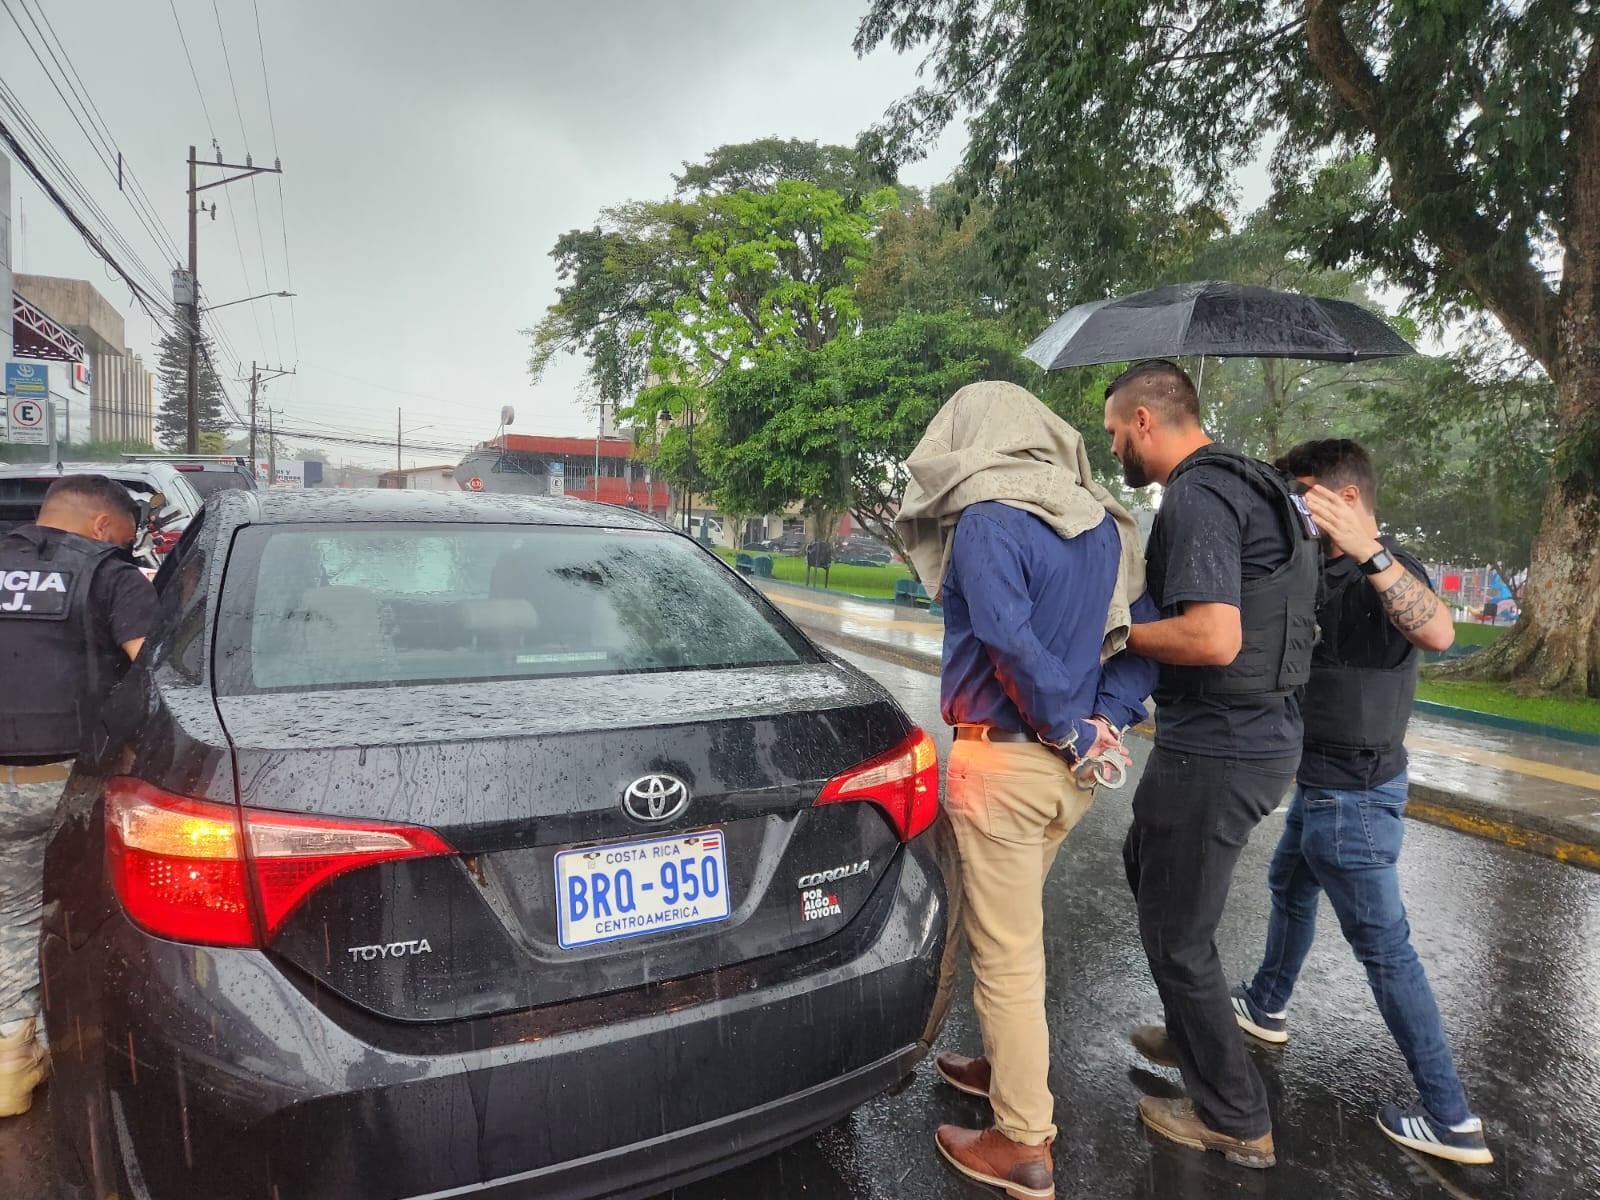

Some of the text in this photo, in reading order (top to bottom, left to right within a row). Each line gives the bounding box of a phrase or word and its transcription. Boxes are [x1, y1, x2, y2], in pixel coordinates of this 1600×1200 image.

[22, 406, 34, 421] E
[606, 844, 680, 864] COSTA RICA
[798, 860, 870, 889] COROLLA
[568, 855, 719, 922] BRQ-950
[803, 889, 822, 901] POR
[804, 897, 830, 911] ALGO
[804, 904, 841, 921] TOYOTA
[595, 906, 699, 934] CENTROAMERICA
[348, 939, 432, 962] TOYOTA
